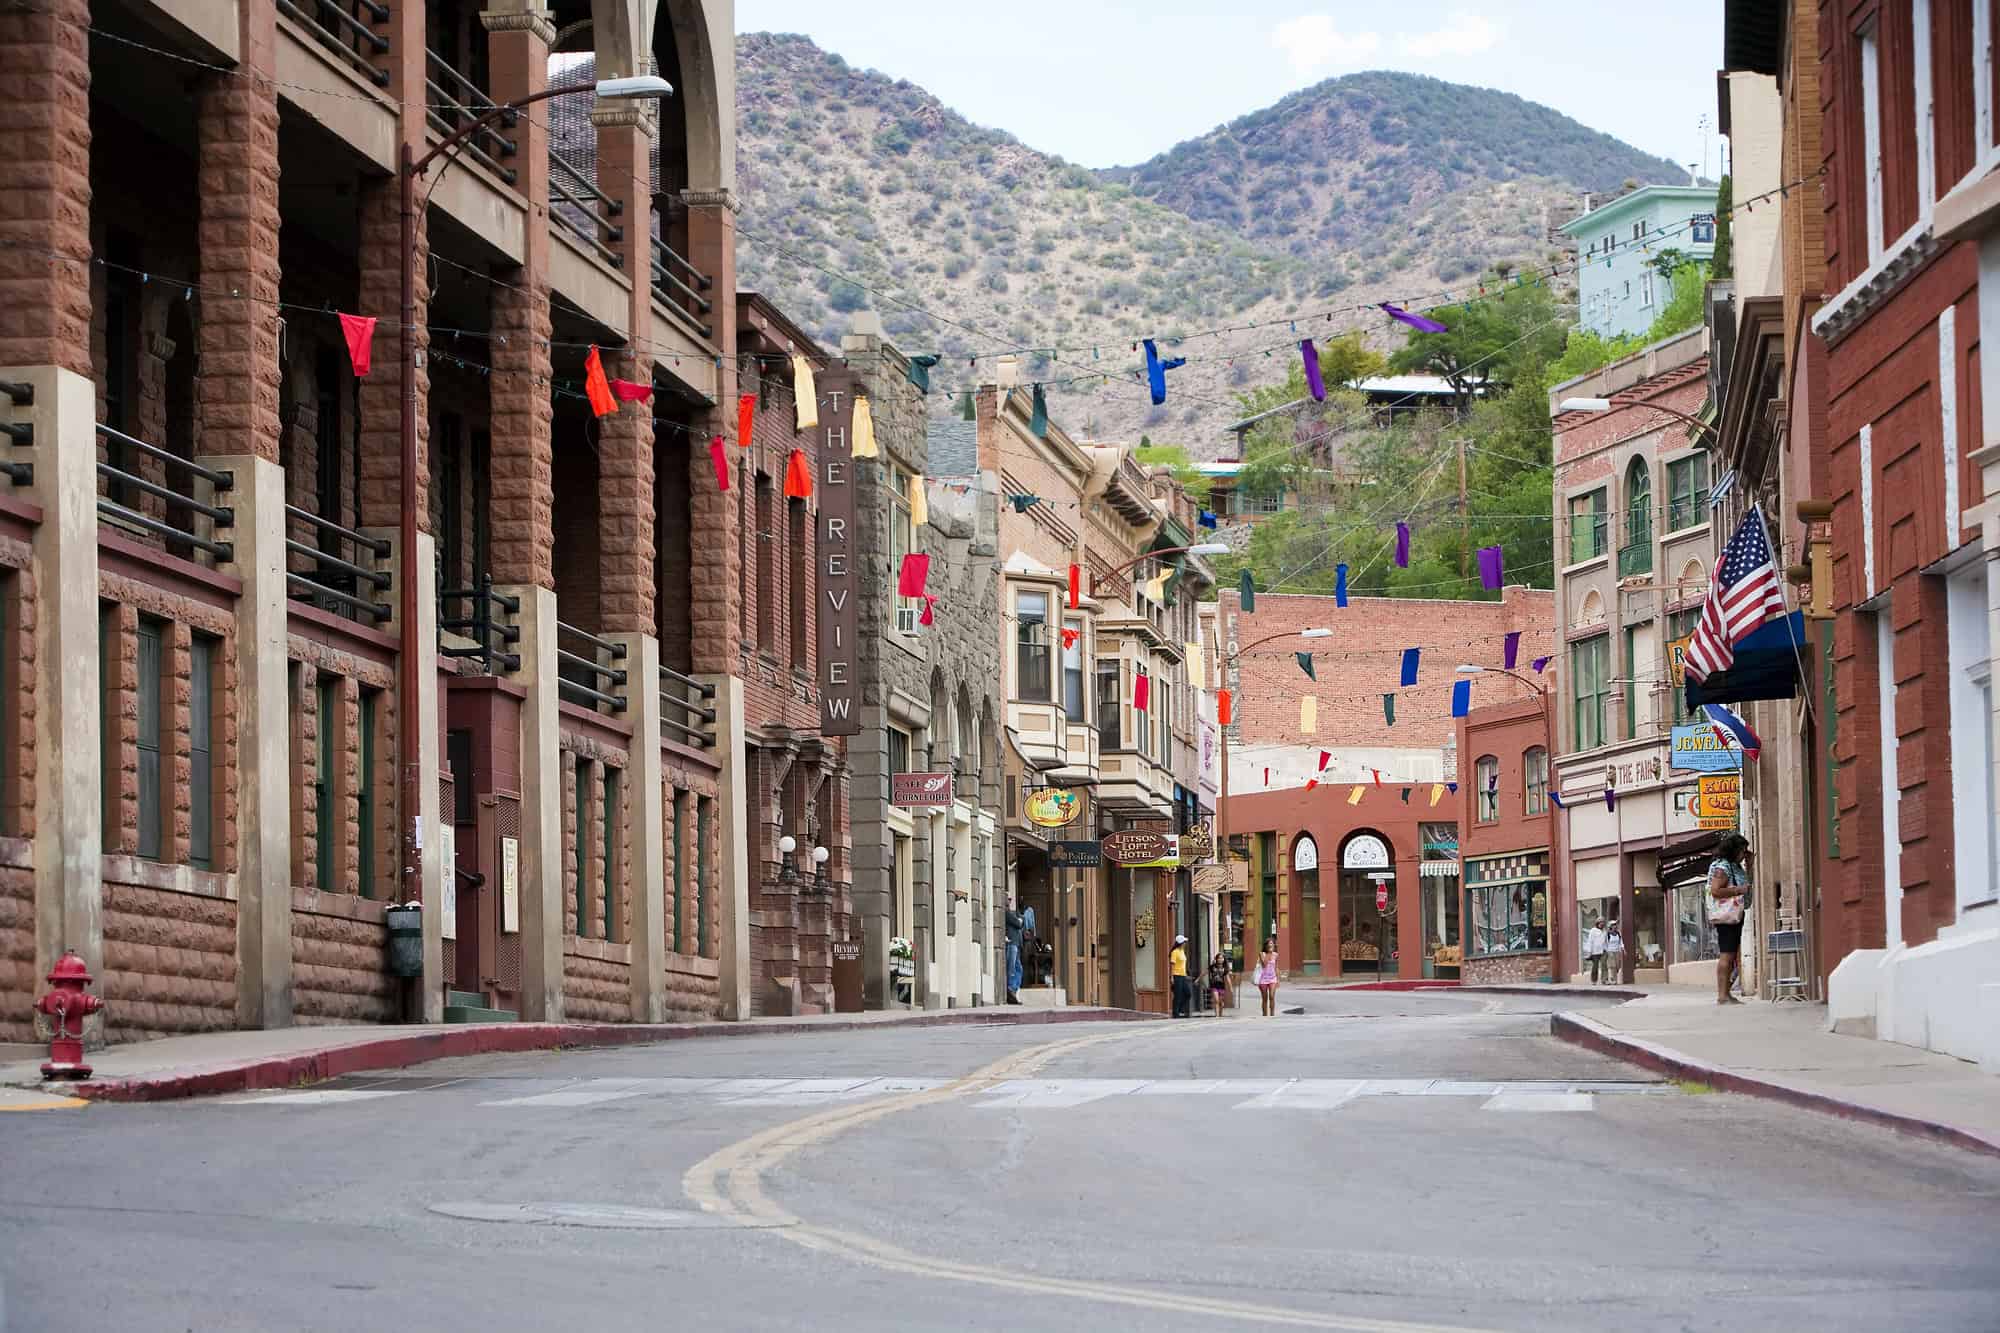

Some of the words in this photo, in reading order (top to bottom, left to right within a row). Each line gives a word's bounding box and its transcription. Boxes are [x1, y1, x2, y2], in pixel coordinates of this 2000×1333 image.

[826, 390, 847, 485] THE
[827, 518, 851, 720] REVIEW
[1675, 735, 1729, 752] JEWEL
[1617, 763, 1633, 785] THE
[1115, 831, 1157, 844] LETSON
[1121, 842, 1149, 851] LOFT
[1118, 850, 1154, 860] HOTEL
[833, 943, 860, 953] REVIEW
